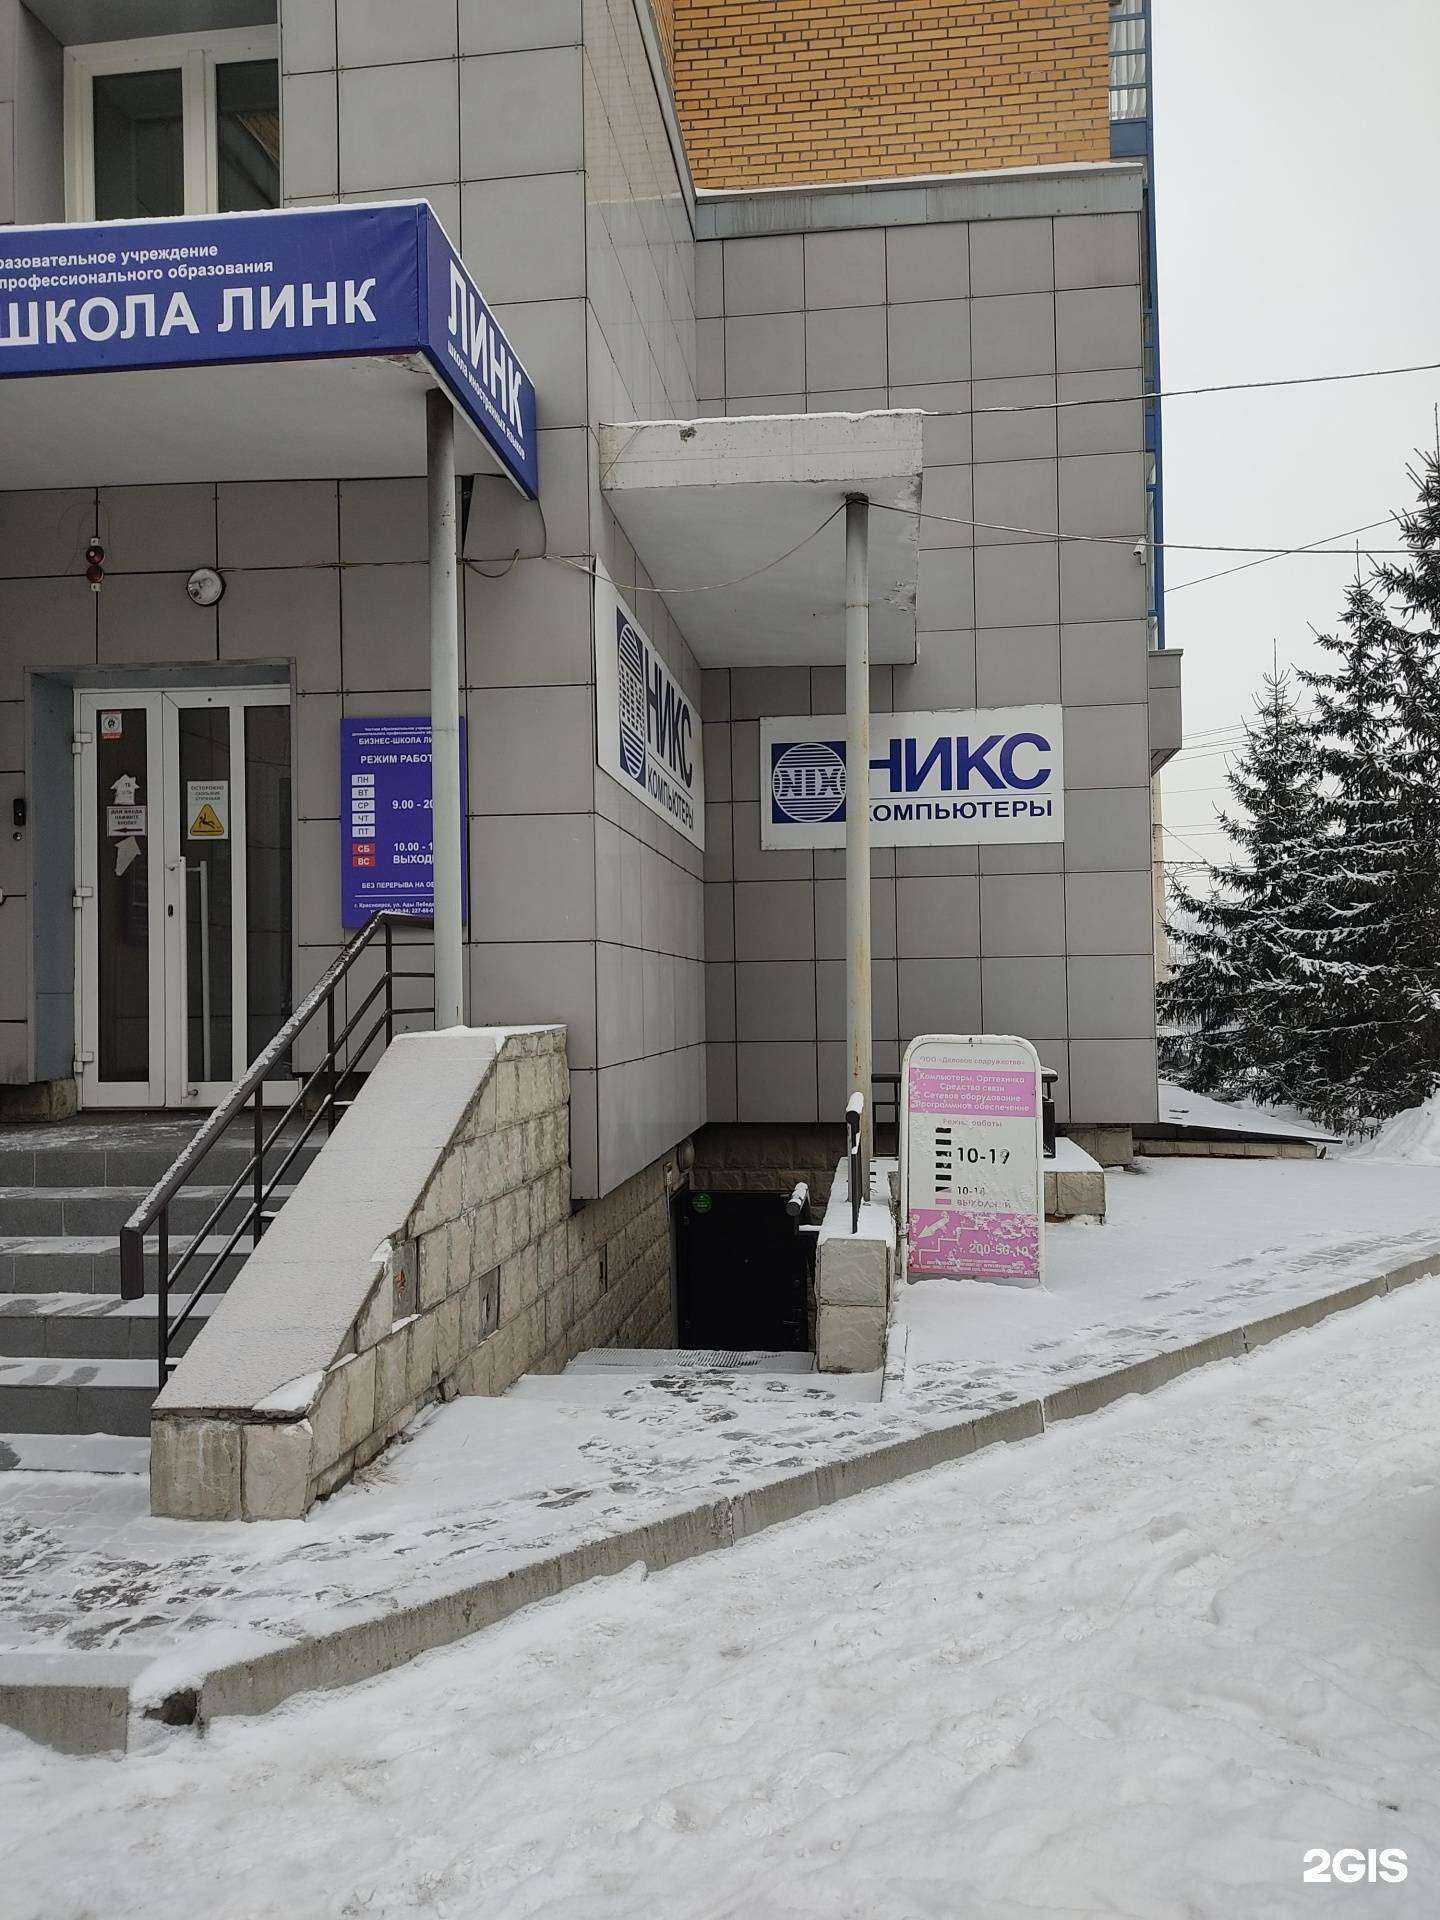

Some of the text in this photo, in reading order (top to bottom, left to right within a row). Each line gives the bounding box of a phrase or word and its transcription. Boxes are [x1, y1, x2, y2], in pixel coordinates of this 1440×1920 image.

[121, 245, 218, 265] учреждение
[0, 261, 274, 291] профессионального образования
[0, 278, 377, 347] ШКОЛА ЛИНК
[448, 259, 524, 439] ЛИНК
[645, 646, 693, 788] НИКС
[358, 737, 422, 745] БИЗНЕС-ШКОЛА
[360, 754, 433, 764] РЕЖИМ РАБОТ
[357, 776, 369, 784] ПН
[358, 789, 369, 797] ВТ
[647, 763, 694, 831] КОМПЬЮТЕРЫ
[392, 800, 414, 809] 9.00
[423, 799, 434, 809] 20
[869, 799, 1052, 822] ОМПЬЮТЕРЫ
[357, 845, 370, 853] СБ
[393, 842, 419, 852] 10.00
[393, 854, 433, 865] ВЫХОД
[939, 1083, 981, 1092] Средства
[923, 1091, 1021, 1104] Сетевое оборудование
[974, 1102, 1030, 1112] обеспечение
[957, 1147, 1010, 1164] 10-19
